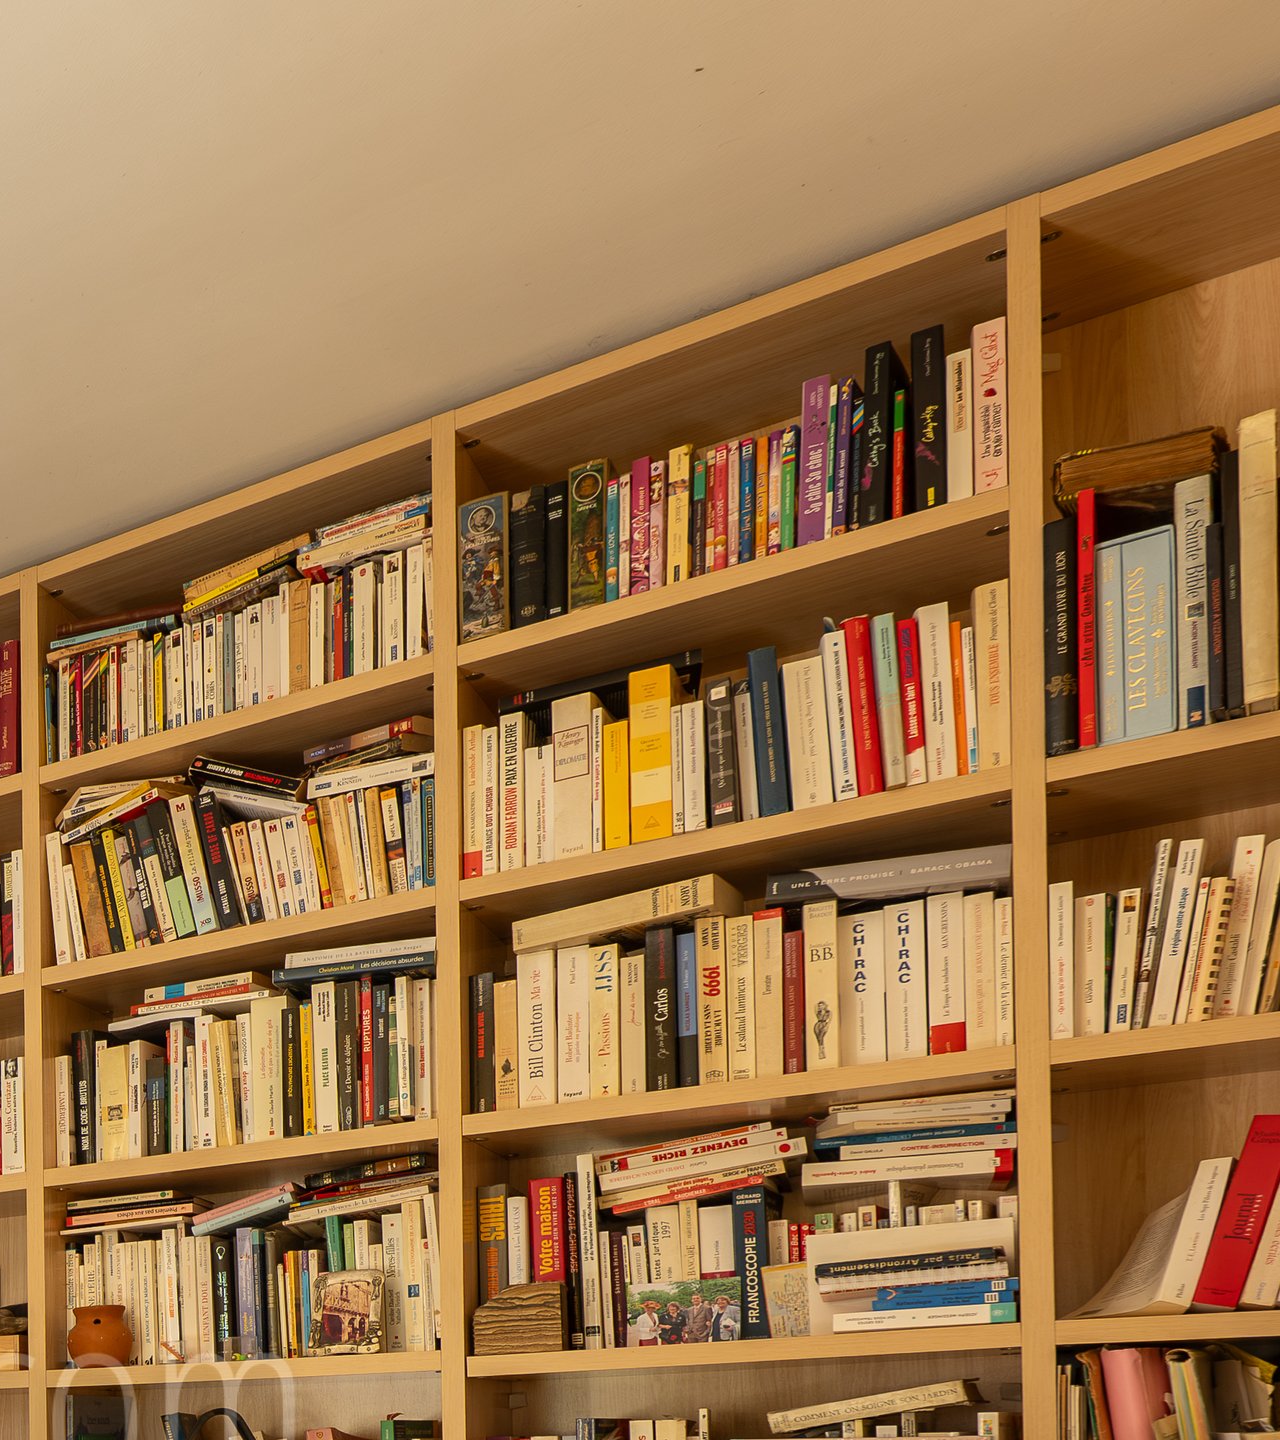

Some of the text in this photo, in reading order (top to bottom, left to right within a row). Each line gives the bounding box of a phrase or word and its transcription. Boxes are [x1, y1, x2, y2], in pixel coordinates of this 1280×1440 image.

[1185, 498, 1205, 599] La Sainte Bible
[1055, 550, 1068, 654] LE GRAND LIVRE DU LION
[1126, 567, 1146, 711] LES CLAVECINS
[505, 722, 518, 849] RONAN FARROW PAIX EN GUERRE
[791, 858, 993, 889] UNE TERRE PROMISE BARACK OBAMA
[595, 949, 613, 993] JJSS
[852, 923, 866, 993] CHIRAC
[897, 912, 911, 984] CHIRAC
[653, 987, 669, 1022] Carlos
[702, 965, 721, 997] 1999
[362, 1009, 372, 1052] RUPTURES
[527, 970, 544, 1079] Bill Clinton Ma vie
[597, 1012, 612, 1057] Passions
[735, 977, 747, 1052] Le salaud lumineux
[320, 1047, 330, 1087] PLACE BEAUVAU
[3, 1081, 13, 1135] Julio Cortázar
[651, 1137, 748, 1163] DEVENEZ RICHE
[536, 1185, 553, 1276] Votre maison
[660, 1221, 671, 1240] 1997
[1221, 1193, 1259, 1245] Journal
[385, 1237, 396, 1278] Mères-filles
[743, 1212, 759, 1323] FRANCOSCOPIE 2030
[830, 1252, 981, 1274] Paris par Arrondissement
[793, 1387, 959, 1424] COMMENT ON SOIGNE SON JARDIN
